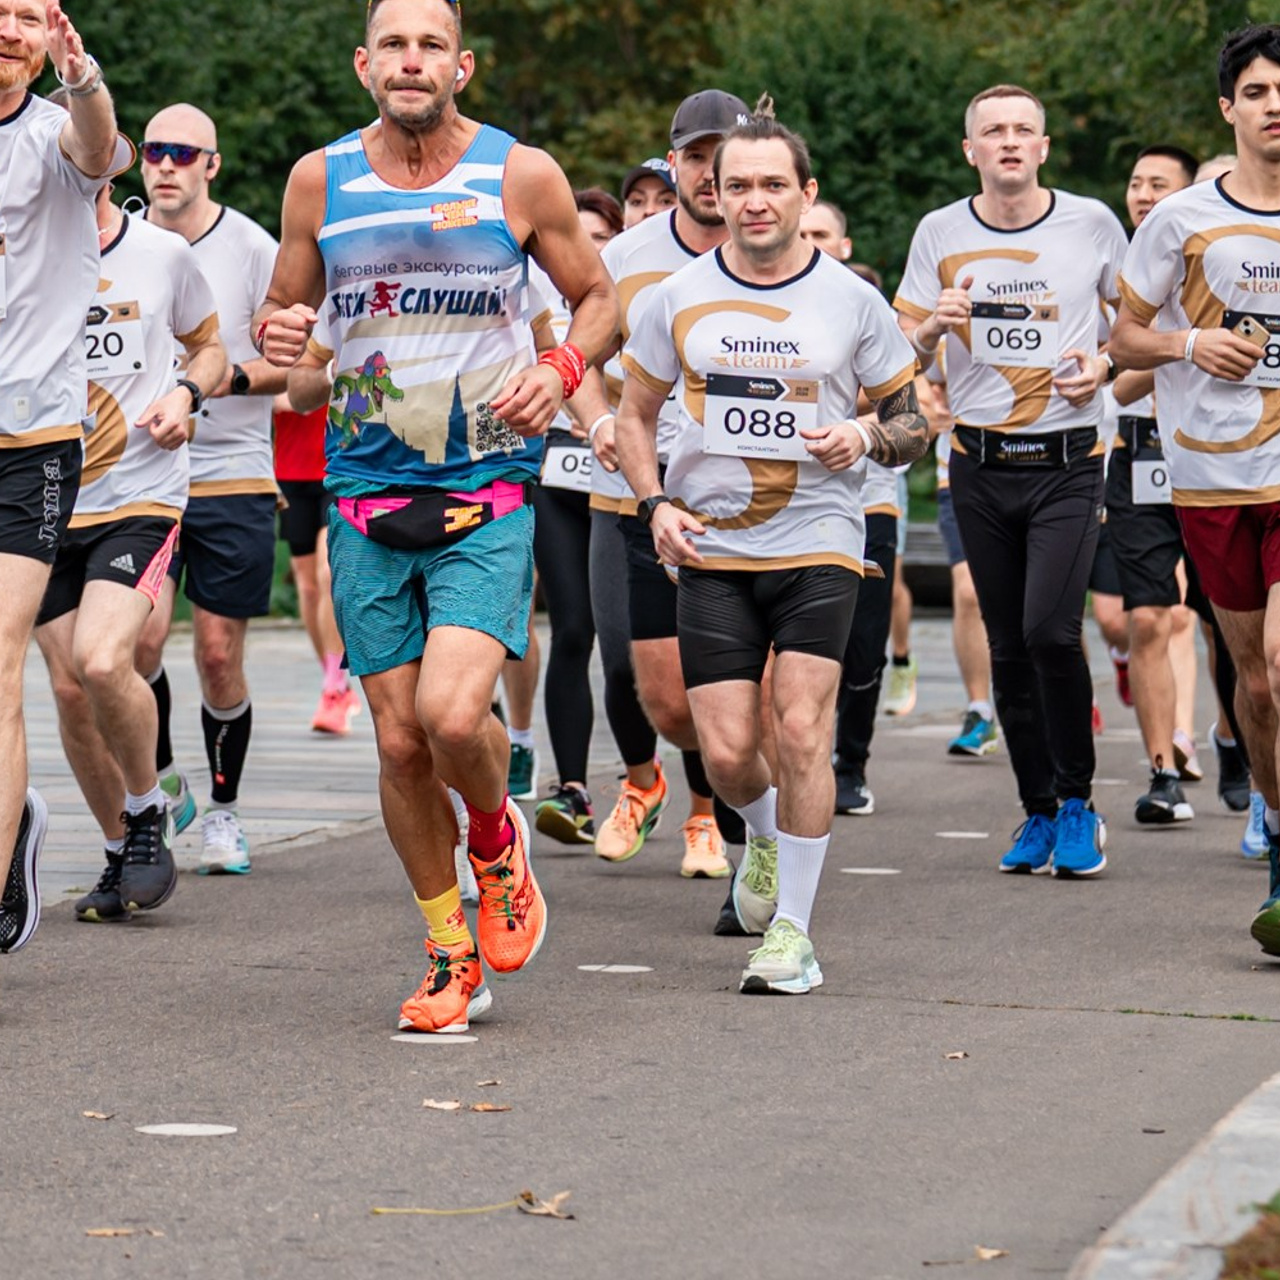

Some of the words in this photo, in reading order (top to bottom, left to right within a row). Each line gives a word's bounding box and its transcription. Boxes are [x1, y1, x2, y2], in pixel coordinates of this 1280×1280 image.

[334, 262, 398, 278] беговые
[403, 261, 499, 277] экскурсии
[986, 279, 1049, 297] Sminex
[400, 285, 507, 318] СЛУШАЙ!
[85, 331, 124, 359] 20
[720, 335, 800, 355] Sminex
[987, 326, 1042, 350] 069
[733, 353, 787, 369] team
[724, 407, 796, 439] 088
[1000, 439, 1047, 453] Sminex
[561, 453, 592, 476] 05
